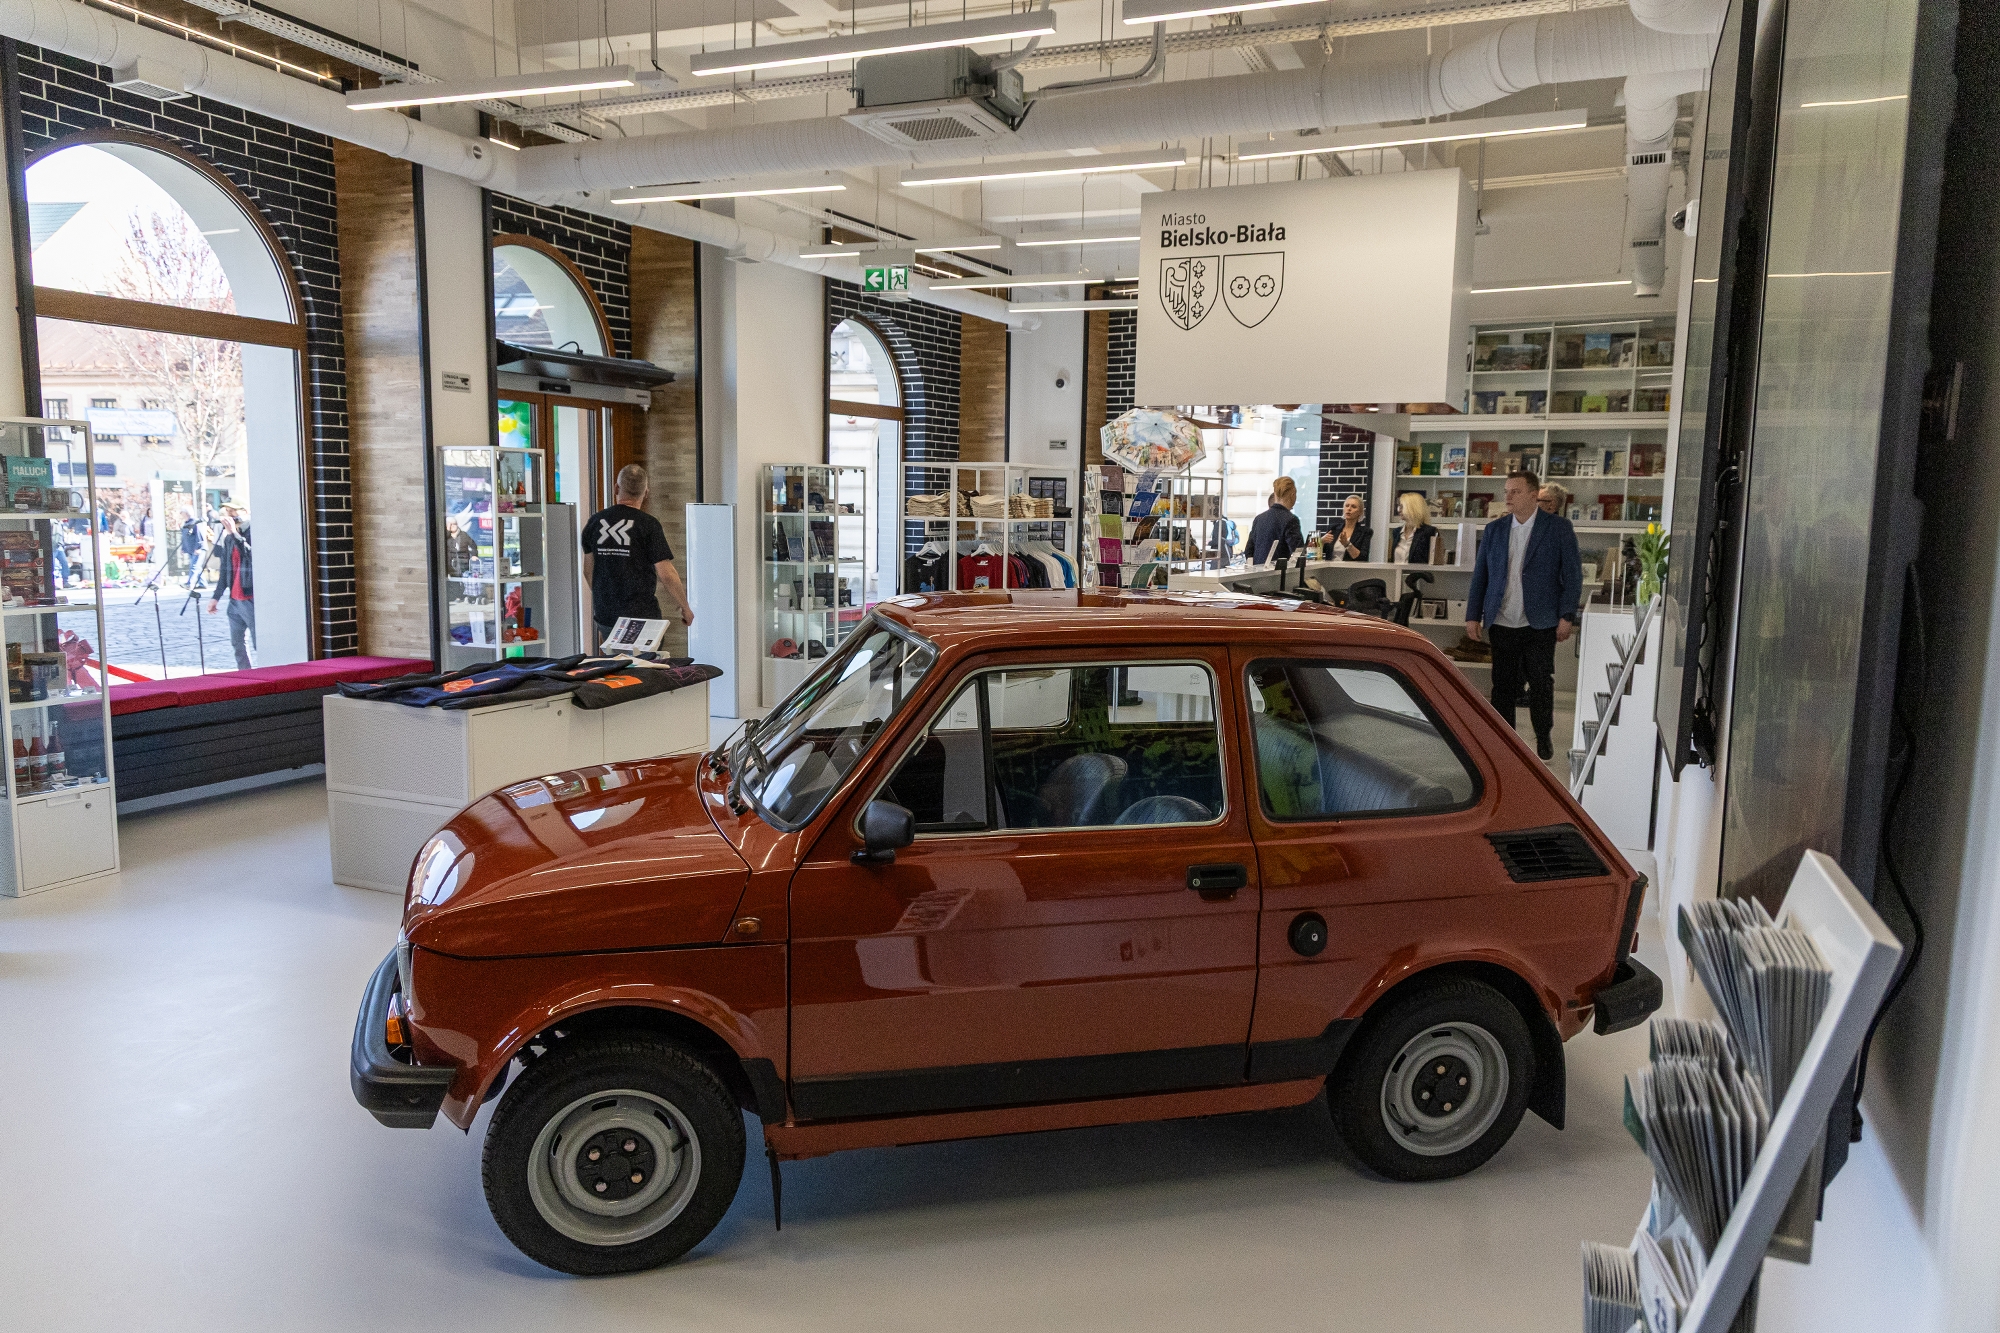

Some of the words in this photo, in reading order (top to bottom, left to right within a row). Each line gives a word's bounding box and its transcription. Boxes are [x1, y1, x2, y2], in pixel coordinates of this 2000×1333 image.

[1161, 213, 1206, 227] Miasto
[1161, 222, 1286, 248] Bielsko-Biała
[12, 465, 47, 477] MALUCH
